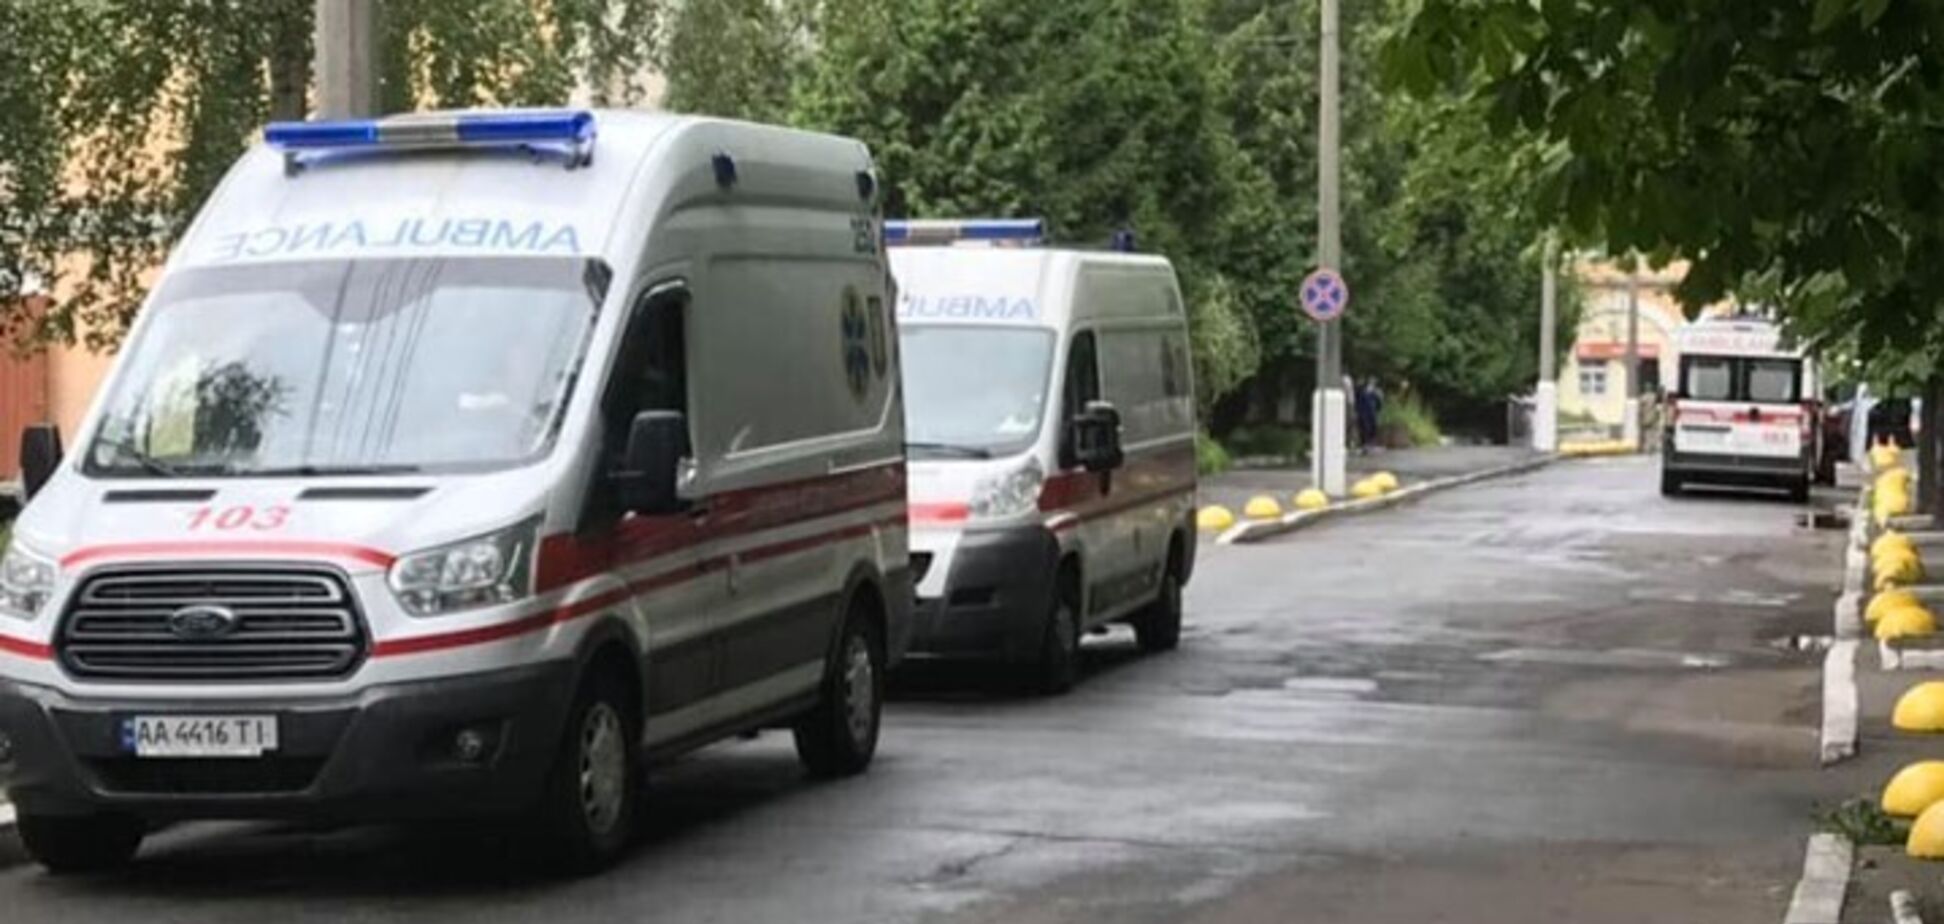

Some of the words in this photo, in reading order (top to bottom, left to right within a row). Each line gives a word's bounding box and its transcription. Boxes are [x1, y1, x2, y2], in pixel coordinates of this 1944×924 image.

[186, 505, 291, 531] 103
[138, 719, 170, 746] AA
[174, 719, 229, 746] 4416
